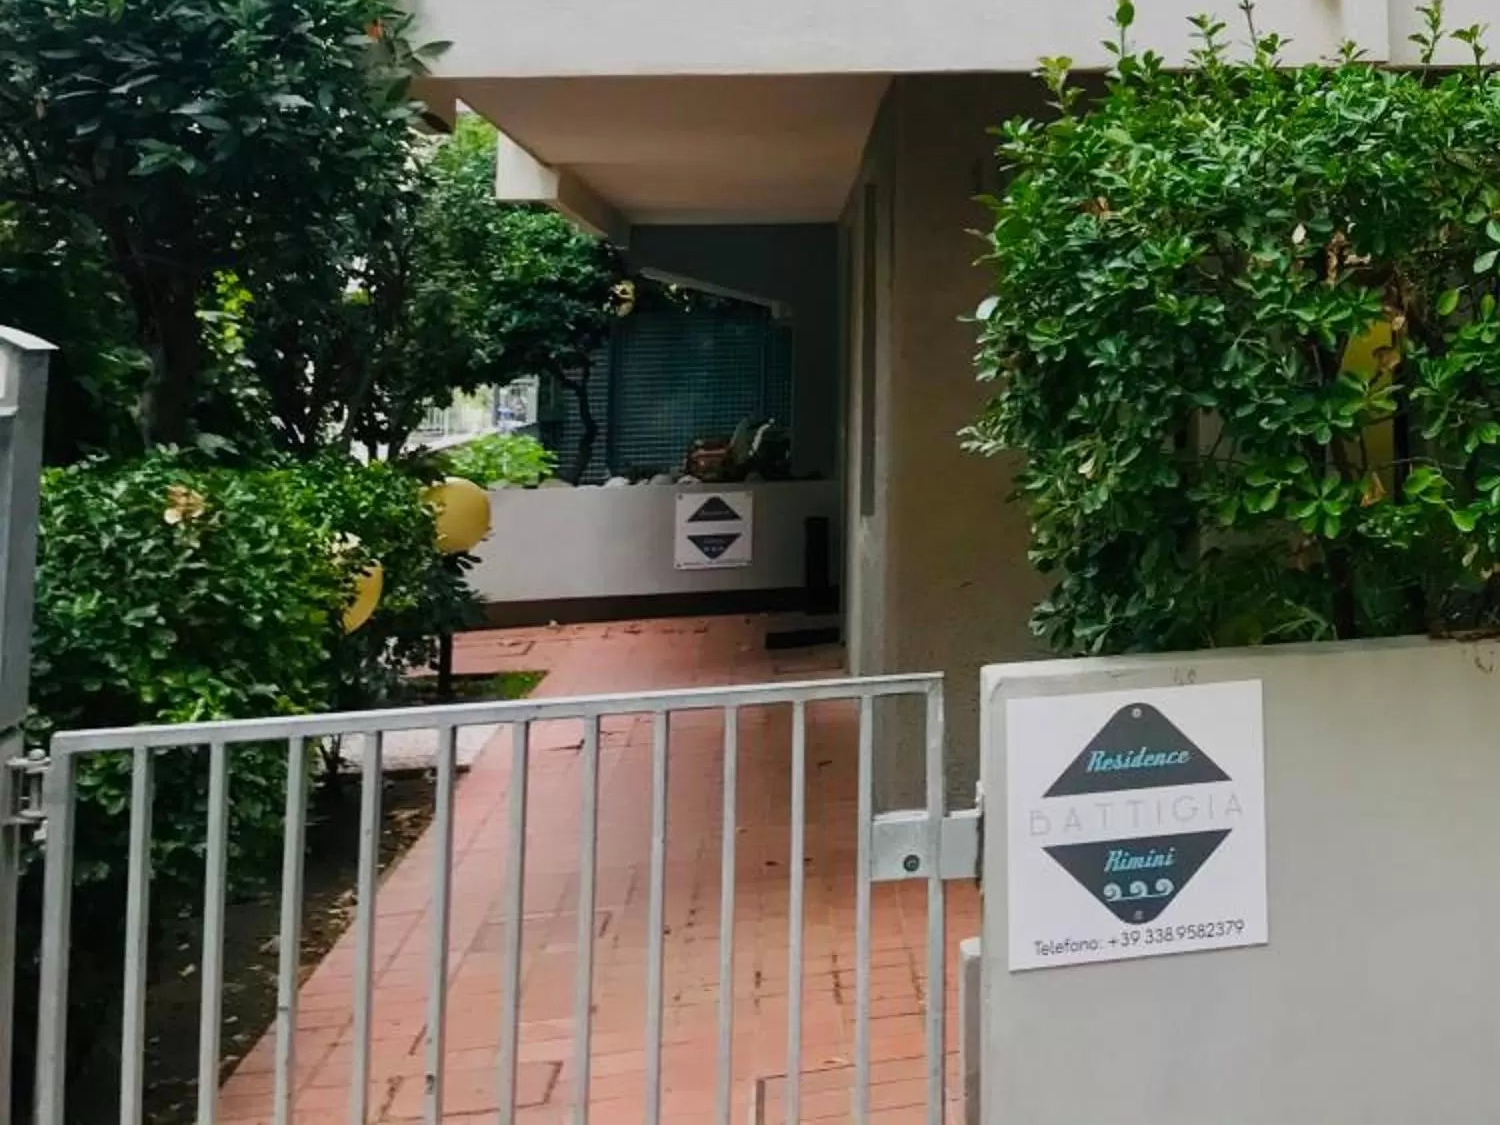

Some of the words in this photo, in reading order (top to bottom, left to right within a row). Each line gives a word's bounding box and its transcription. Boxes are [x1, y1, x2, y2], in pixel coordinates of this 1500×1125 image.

[1086, 747, 1193, 773] Residence
[1029, 791, 1244, 837] BATTIGIA
[1104, 847, 1176, 872] Rimini
[1107, 930, 1141, 948] +39
